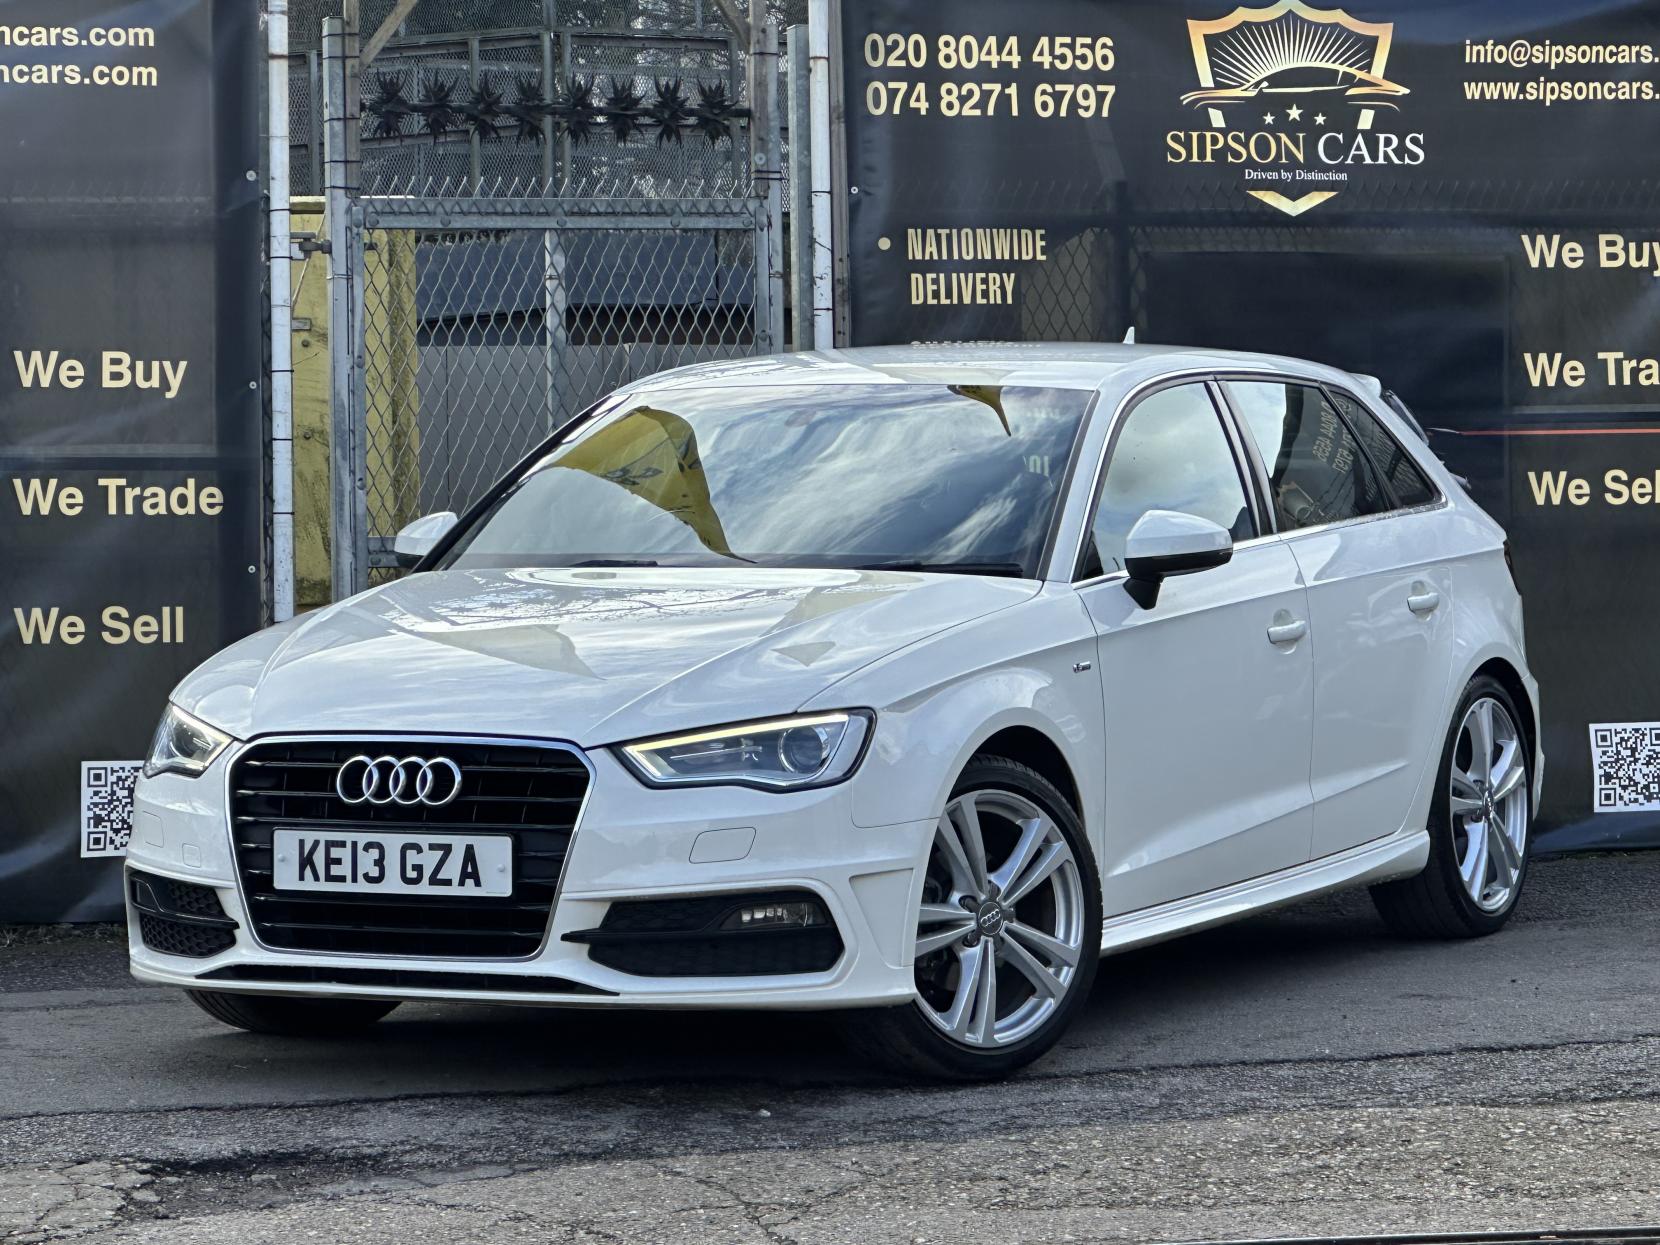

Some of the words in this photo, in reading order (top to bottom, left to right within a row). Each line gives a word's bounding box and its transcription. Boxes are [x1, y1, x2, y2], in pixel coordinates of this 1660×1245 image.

[865, 34, 926, 68] 020
[938, 35, 1021, 69] 8044
[1033, 37, 1114, 71] 4556
[1466, 40, 1659, 69] info@sipsoncars.
[867, 81, 929, 115] 074
[940, 83, 1018, 116] 8271
[1035, 84, 1115, 118] 6797
[1464, 77, 1659, 106] www.sipsoncars.
[1166, 131, 1306, 163] SIPSON
[1317, 132, 1425, 165] CARS
[1244, 168, 1279, 180] Driven
[1281, 169, 1293, 182] by
[1295, 169, 1348, 181] Distinction
[908, 228, 1046, 260] NATIONWIDE
[1521, 235, 1584, 268] We
[911, 273, 1015, 304] DELIVERY
[14, 351, 84, 388] We
[102, 351, 187, 398] Buy
[1524, 353, 1585, 387] We
[1598, 352, 1660, 385] Tra
[13, 479, 83, 516] We
[98, 478, 223, 515] Trade
[1528, 471, 1590, 505] We
[14, 607, 85, 644] We
[102, 606, 183, 644] Sell
[299, 838, 386, 884] KE13
[400, 843, 481, 887] GZA
